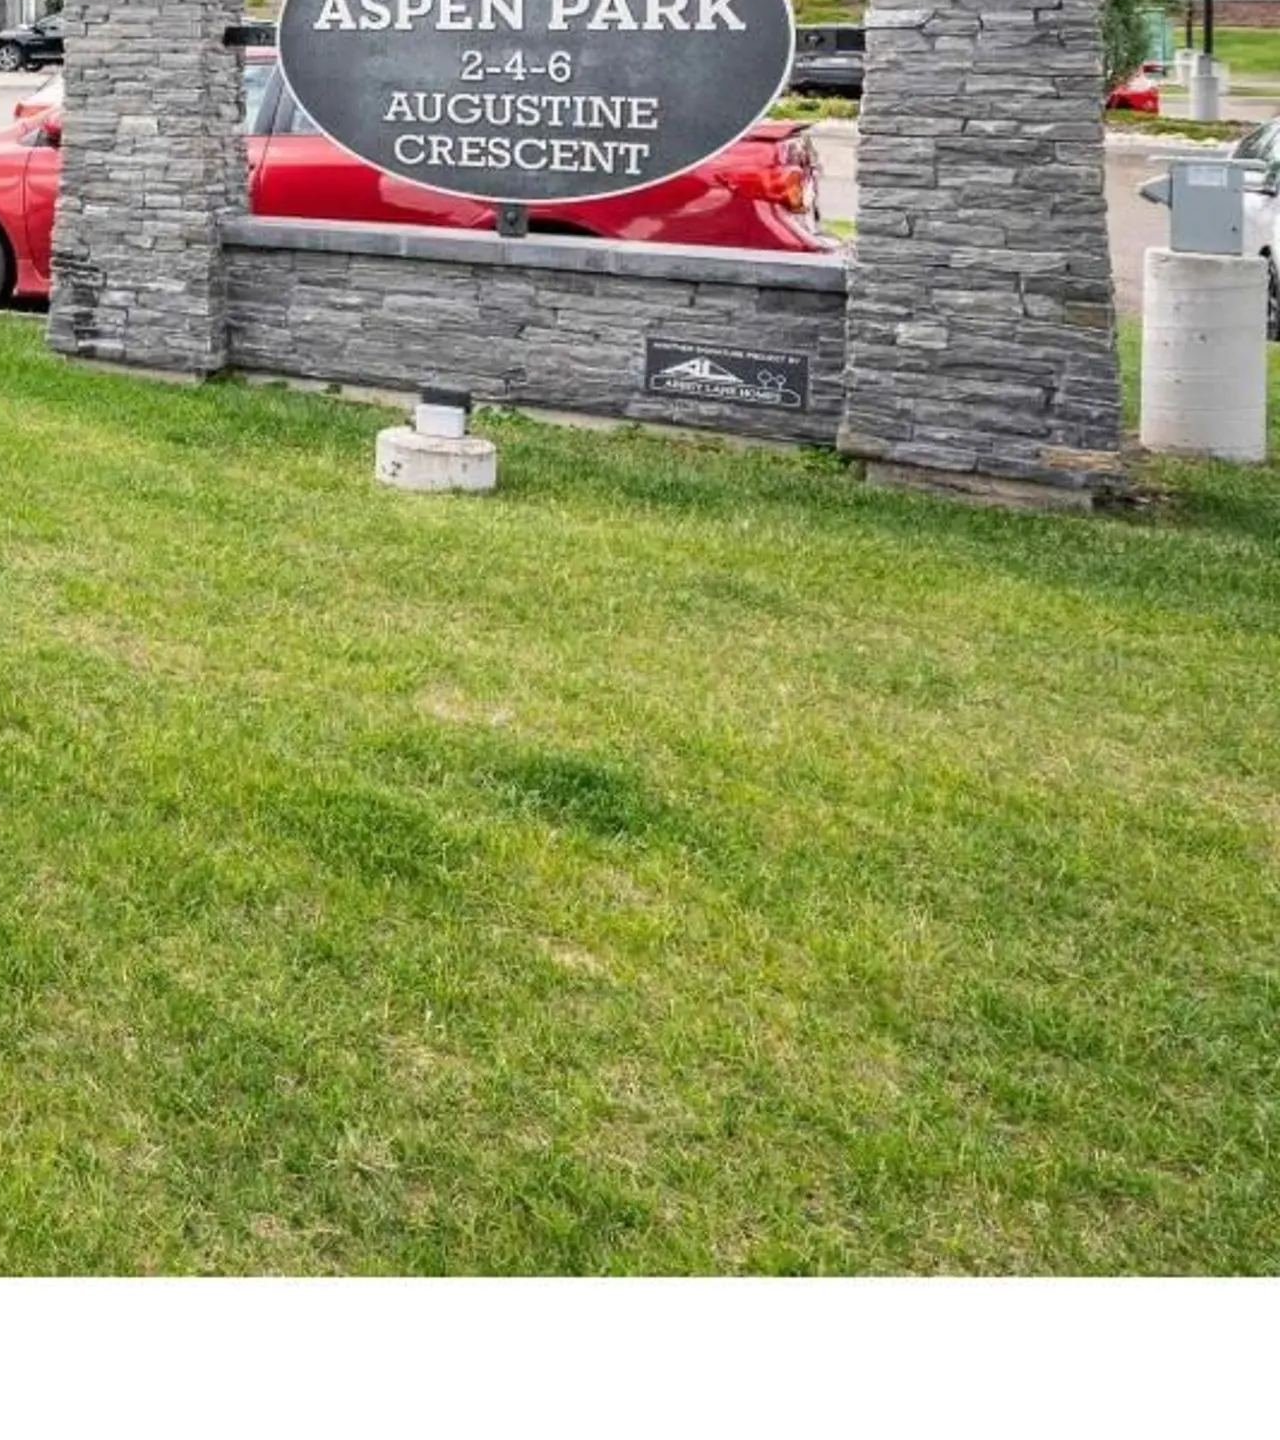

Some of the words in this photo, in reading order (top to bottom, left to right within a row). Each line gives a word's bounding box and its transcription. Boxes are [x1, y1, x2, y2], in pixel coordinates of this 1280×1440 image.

[460, 50, 572, 83] 2-4-6
[383, 92, 658, 129] AUGUSTINE
[394, 134, 650, 174] CRESCENT
